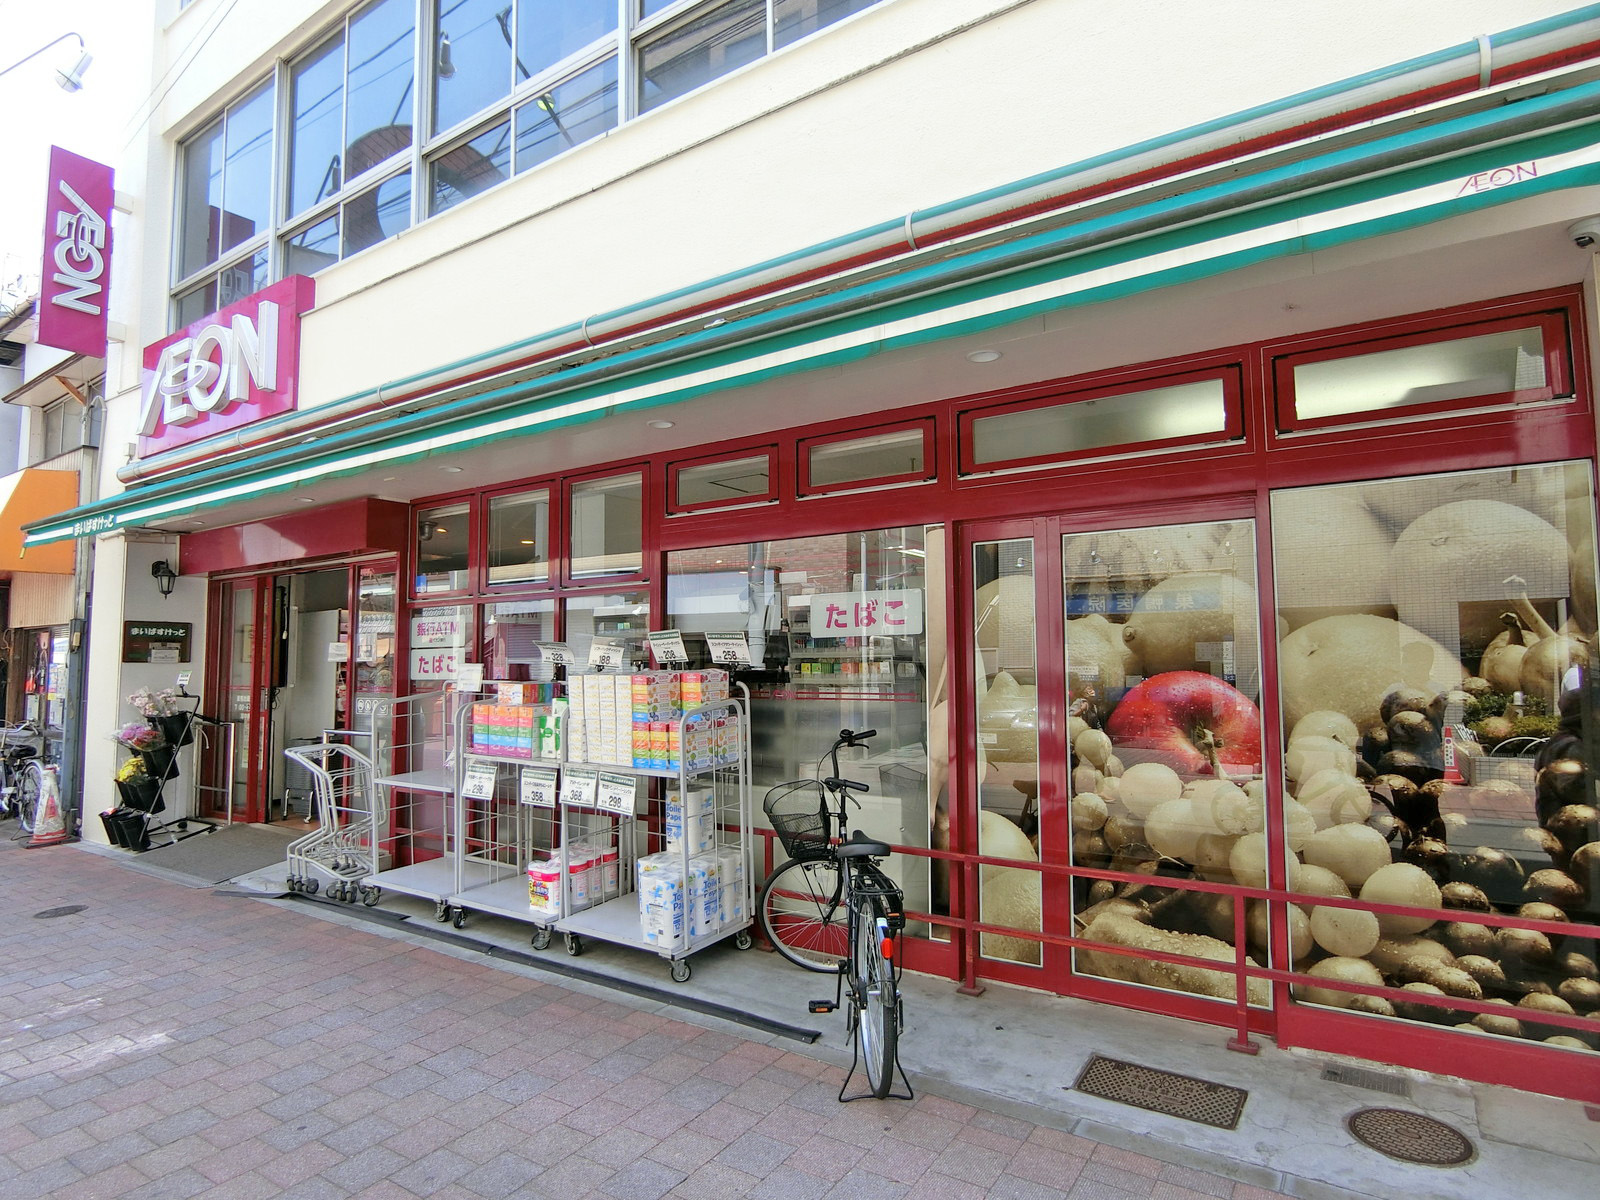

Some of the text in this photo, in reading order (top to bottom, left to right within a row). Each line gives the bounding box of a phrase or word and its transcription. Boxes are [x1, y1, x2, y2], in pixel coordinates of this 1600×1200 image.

[73, 514, 115, 536] まいばすけっと
[825, 599, 906, 629] たばこ
[131, 627, 186, 636] まいばすけっと
[416, 621, 460, 636] 銀行ATM
[599, 655, 611, 665] 188
[663, 649, 677, 660] 208
[722, 650, 737, 660] 258
[418, 654, 456, 673] たばこ
[472, 784, 484, 794] 298
[531, 790, 544, 802] 358
[569, 790, 583, 801] 368
[608, 795, 622, 808] 298
